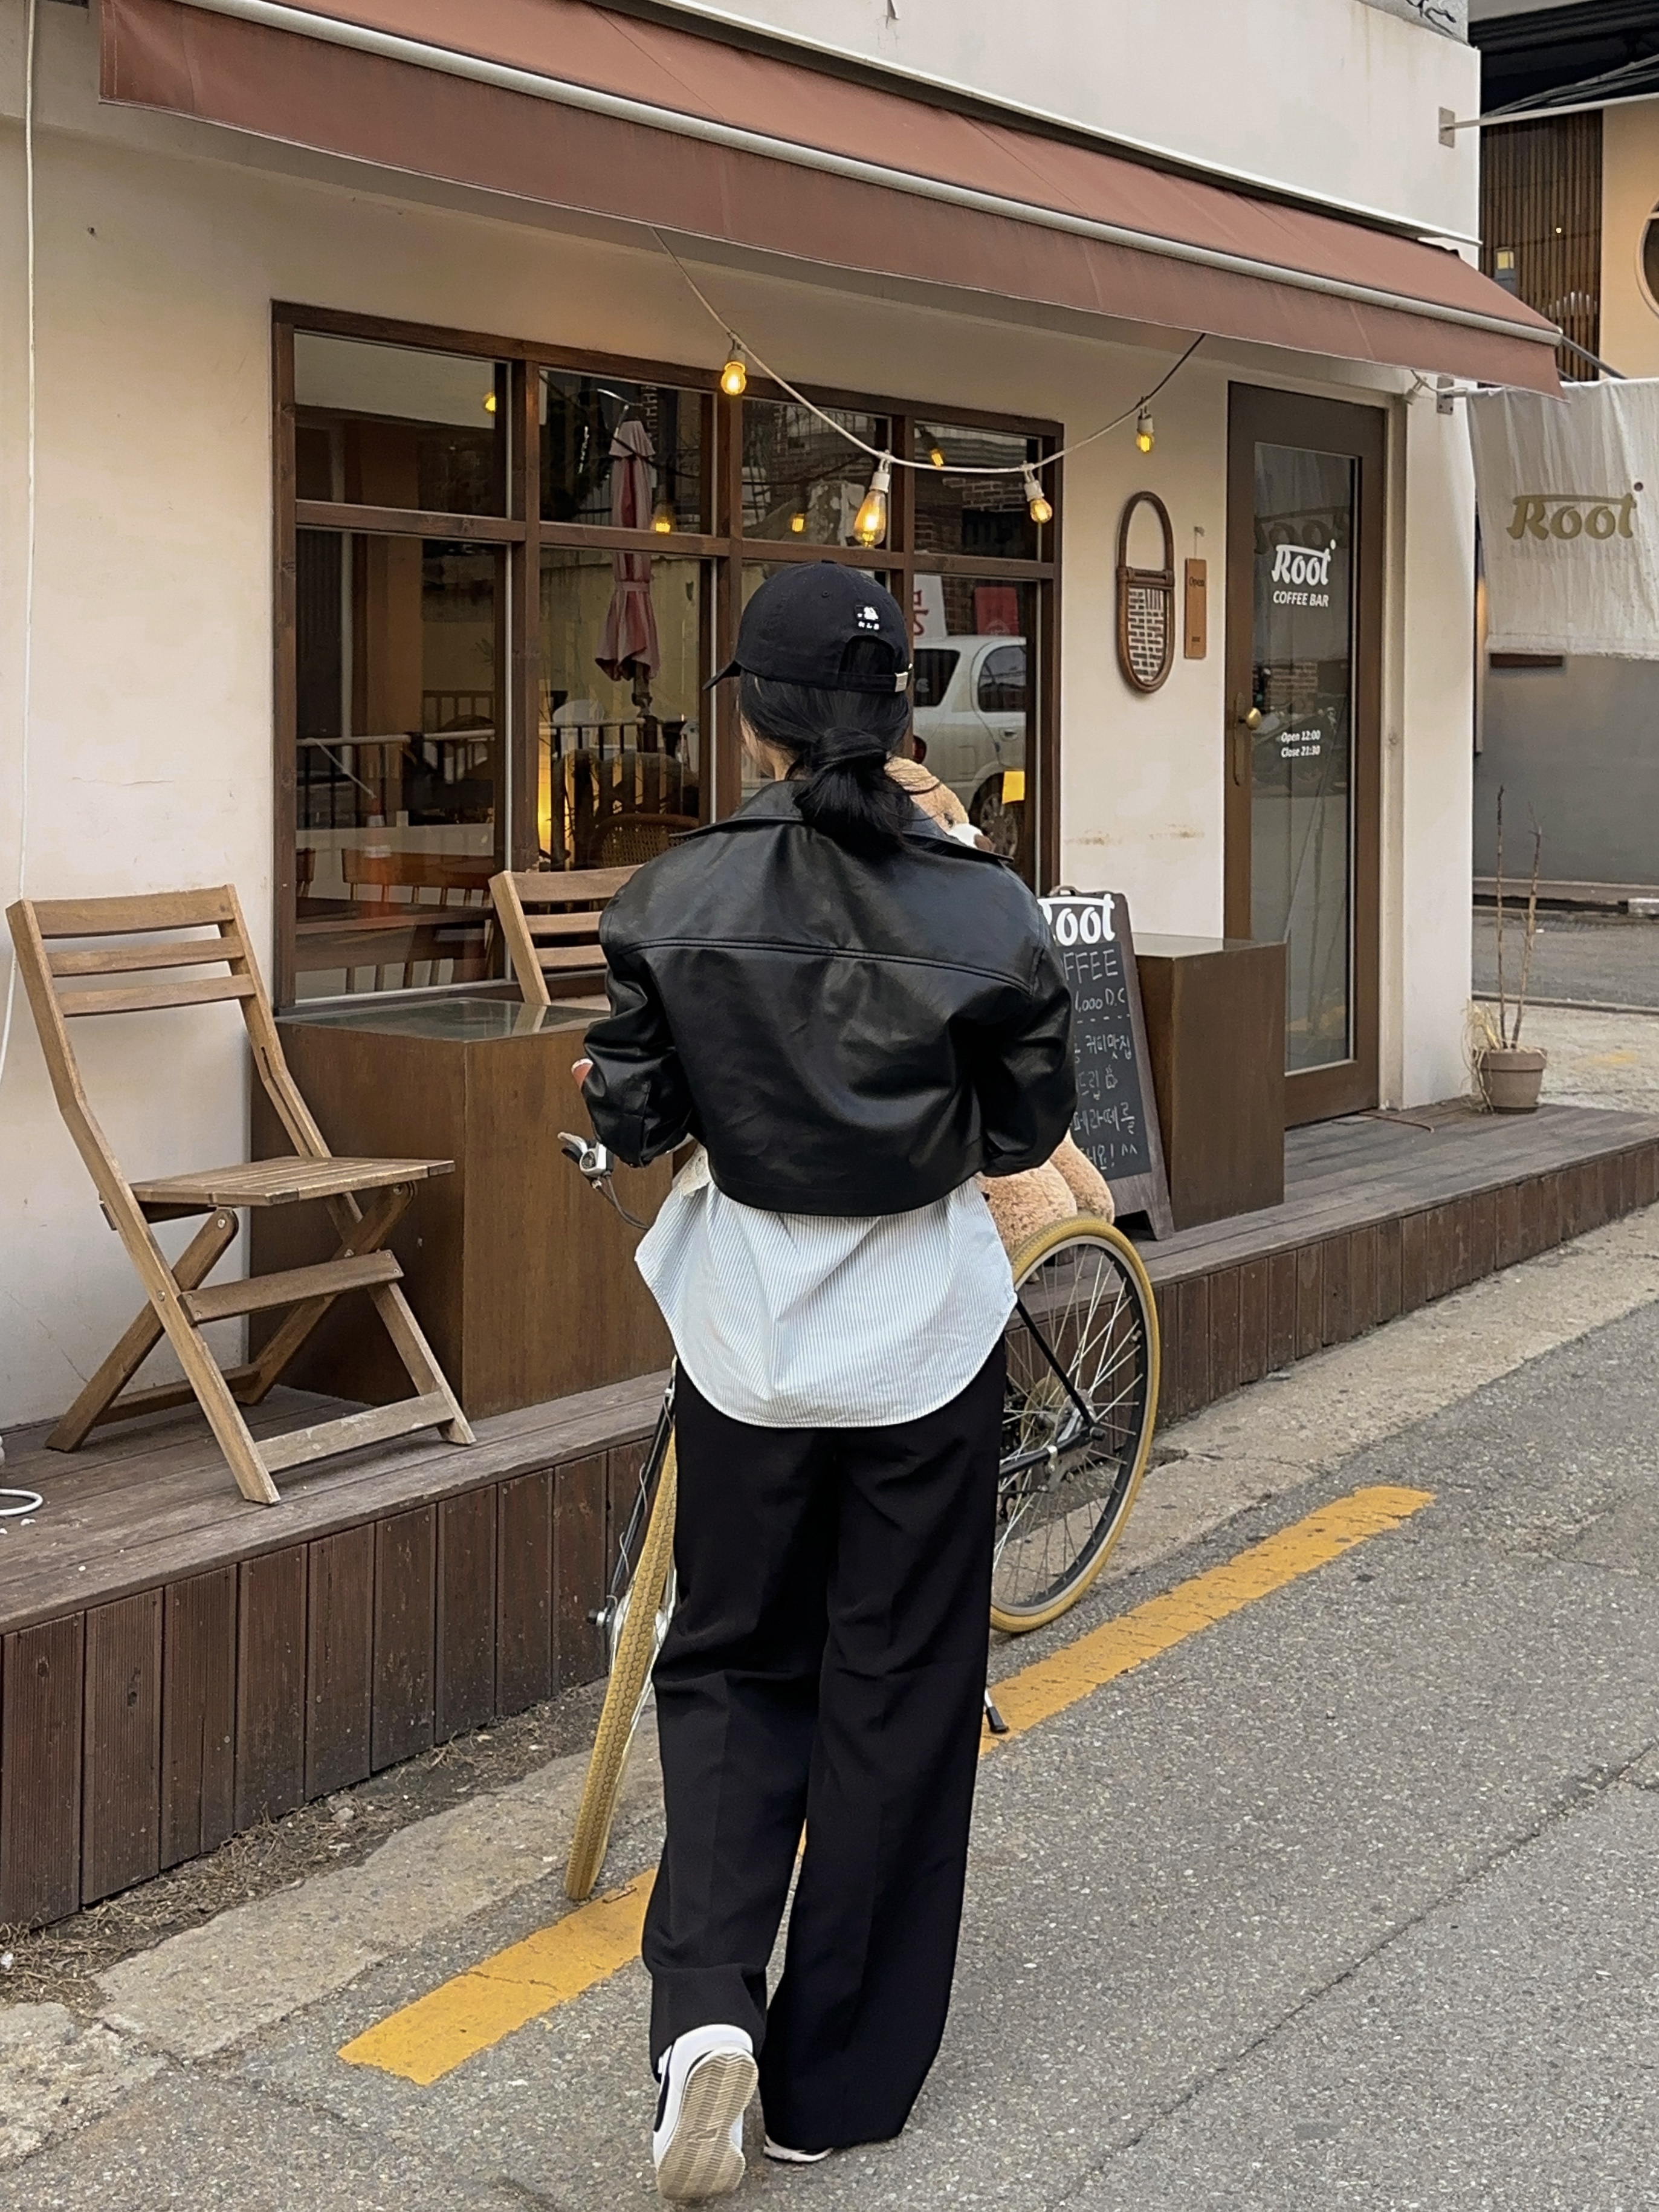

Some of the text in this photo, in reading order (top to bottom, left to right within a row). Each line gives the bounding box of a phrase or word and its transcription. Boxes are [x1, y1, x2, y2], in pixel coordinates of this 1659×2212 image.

[1506, 492, 1637, 540] Root
[1272, 543, 1332, 586] Root
[1273, 590, 1329, 607] COFFEE BAR
[1281, 730, 1321, 744] Open 12:00
[1281, 747, 1300, 758] Close
[1061, 948, 1119, 984] FFEE
